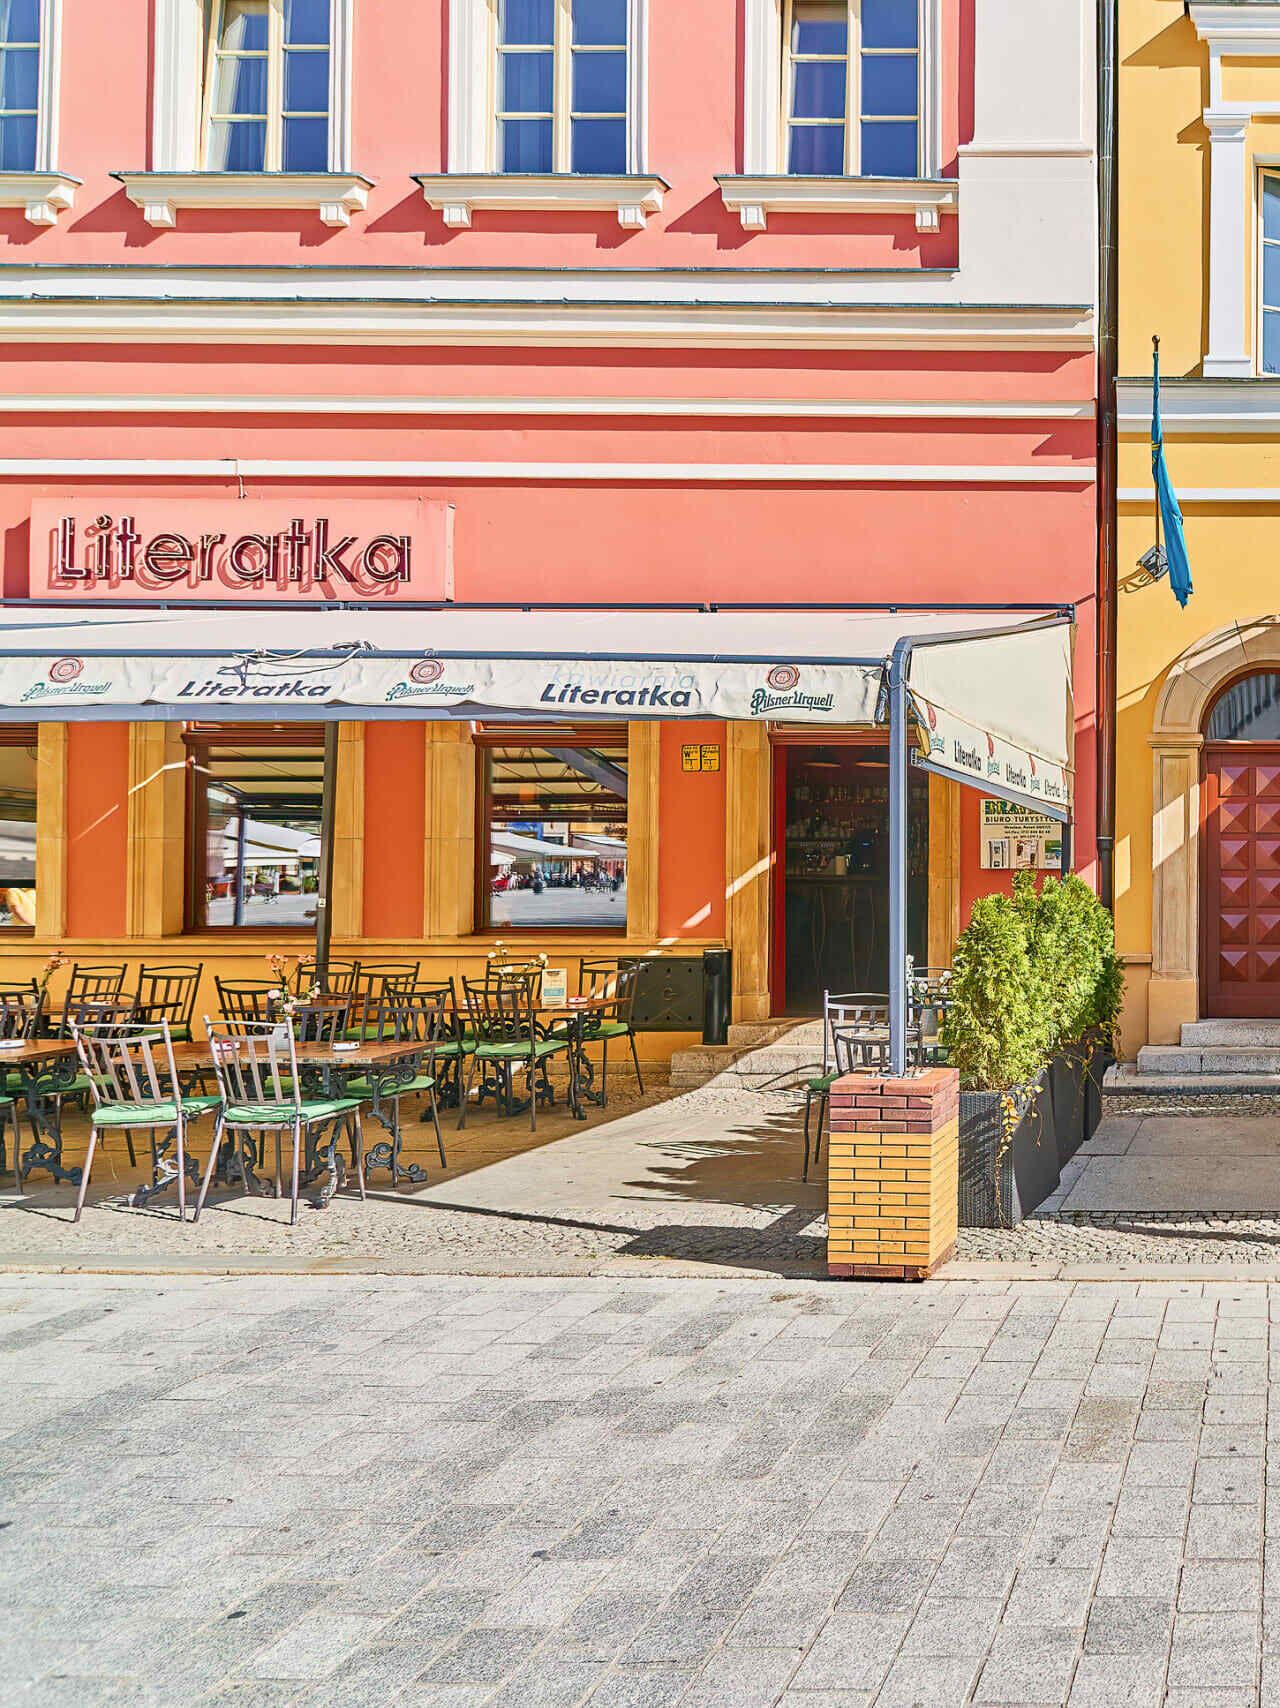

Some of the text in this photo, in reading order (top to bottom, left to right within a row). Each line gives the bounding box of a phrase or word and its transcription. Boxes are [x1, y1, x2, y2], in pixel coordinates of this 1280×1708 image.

[57, 515, 413, 584] Literatka
[176, 680, 332, 697] Literatka
[540, 683, 692, 707] Literatka
[750, 688, 835, 715] Pilsner Urquell
[1014, 815, 1058, 823] TURYSTYC
